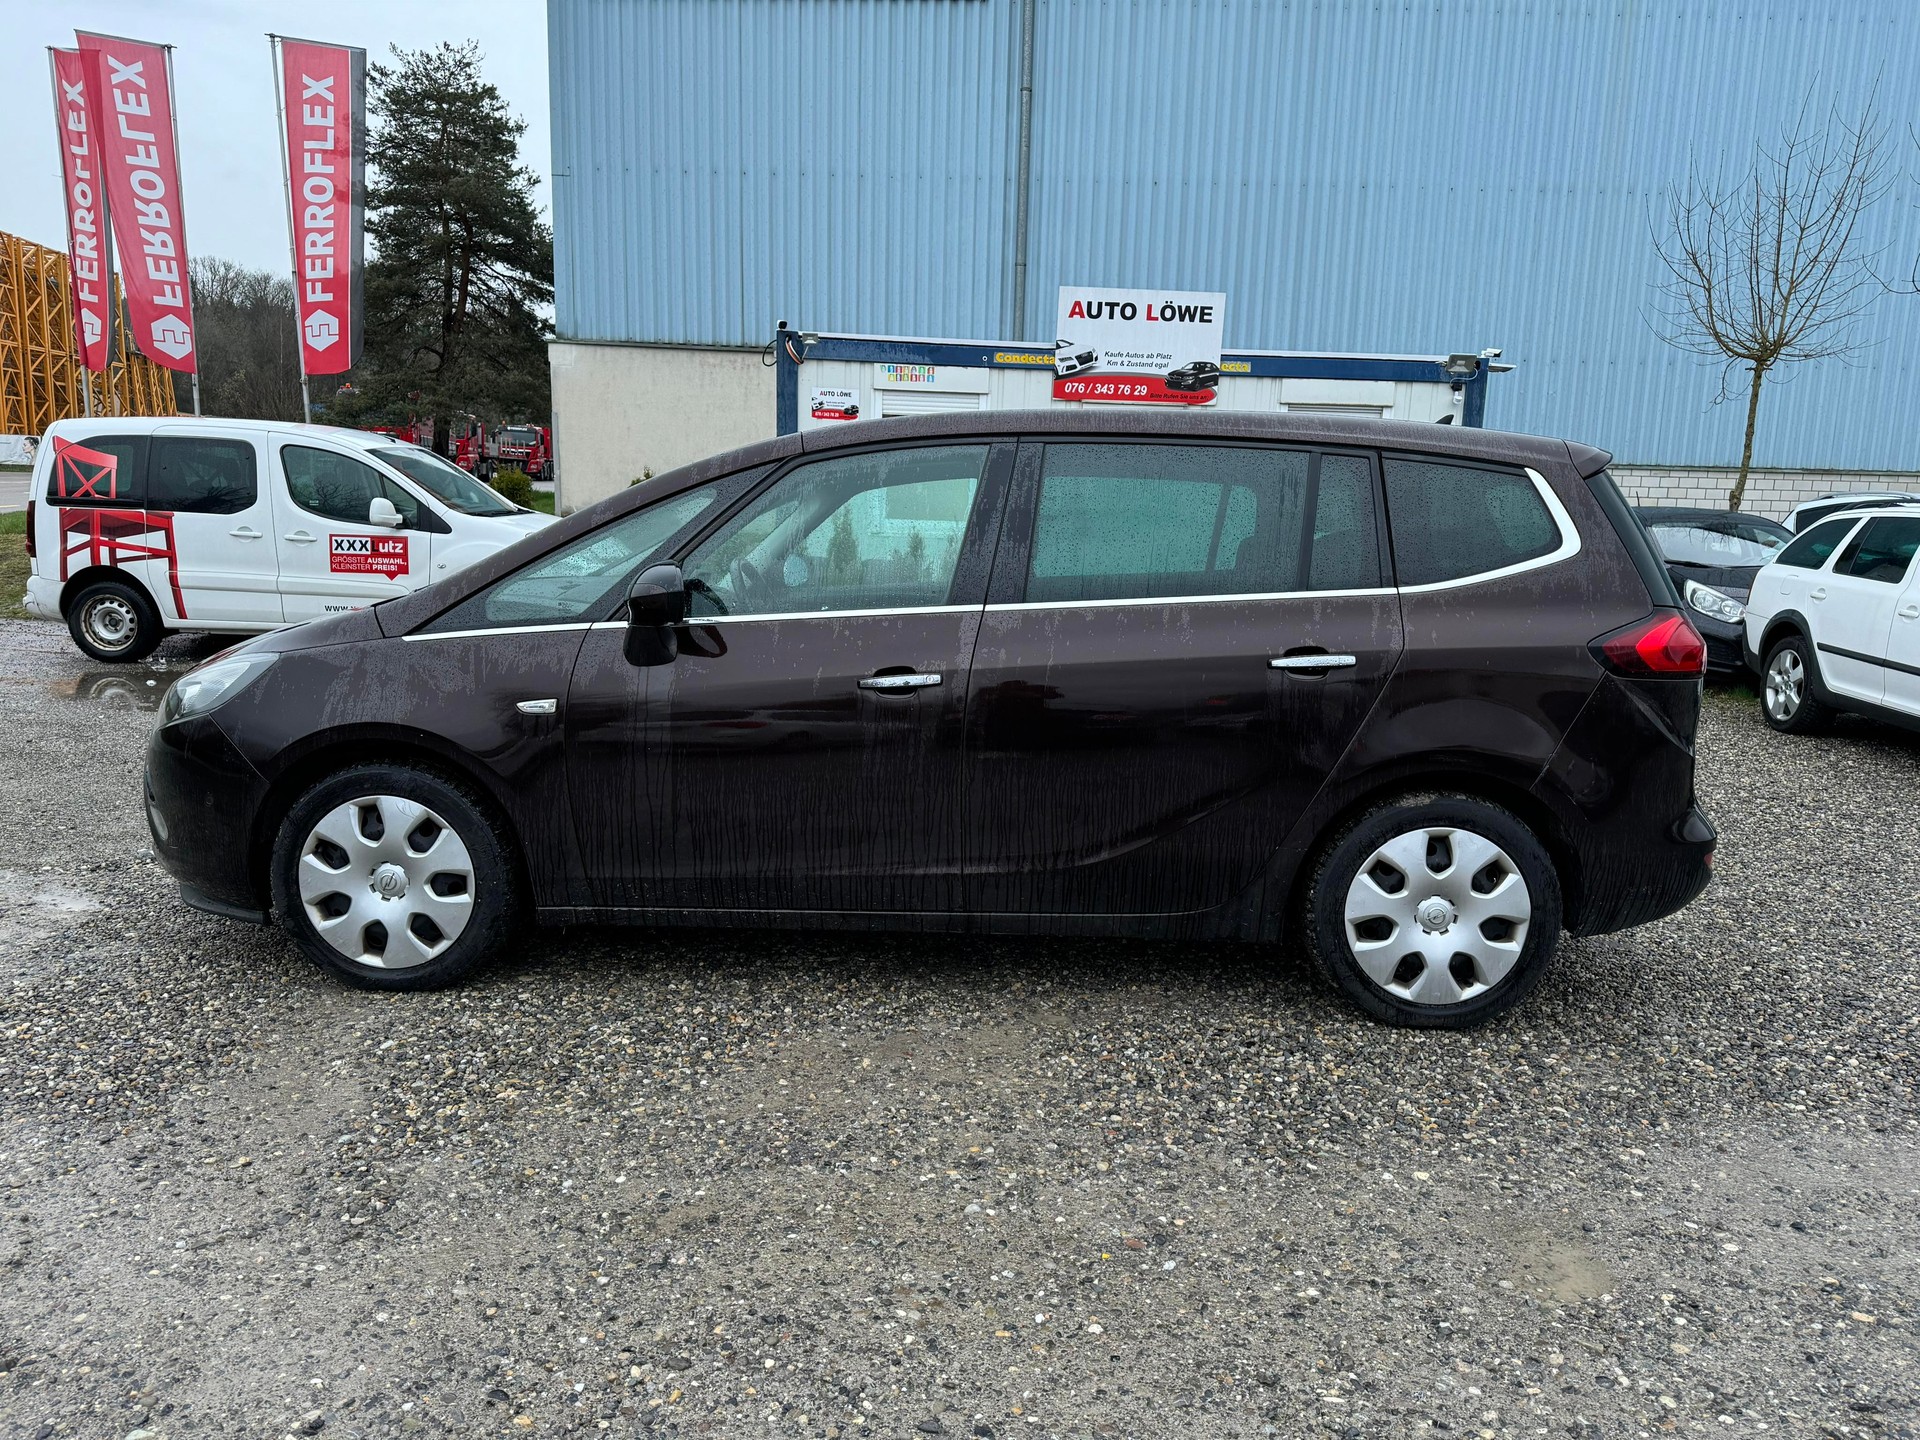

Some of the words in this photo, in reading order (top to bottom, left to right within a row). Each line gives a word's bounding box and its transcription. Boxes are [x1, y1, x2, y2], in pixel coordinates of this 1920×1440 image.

[61, 79, 98, 303] FERROFLEX
[302, 73, 334, 303] FERROFLEX
[1068, 301, 1137, 320] AUTO
[1146, 301, 1213, 323] LÖWE
[995, 352, 1055, 364] Condecta
[1221, 362, 1249, 372] ecta
[1064, 382, 1085, 394] 076
[1086, 383, 1093, 394] /
[1094, 383, 1115, 395] 343
[1117, 384, 1131, 395] 76
[1133, 385, 1148, 396] 29
[333, 539, 404, 553] XXXLutz
[331, 555, 366, 564] GRÖSSTE
[367, 557, 407, 565] AUSWAHL,
[331, 563, 371, 571] KLEINSTER
